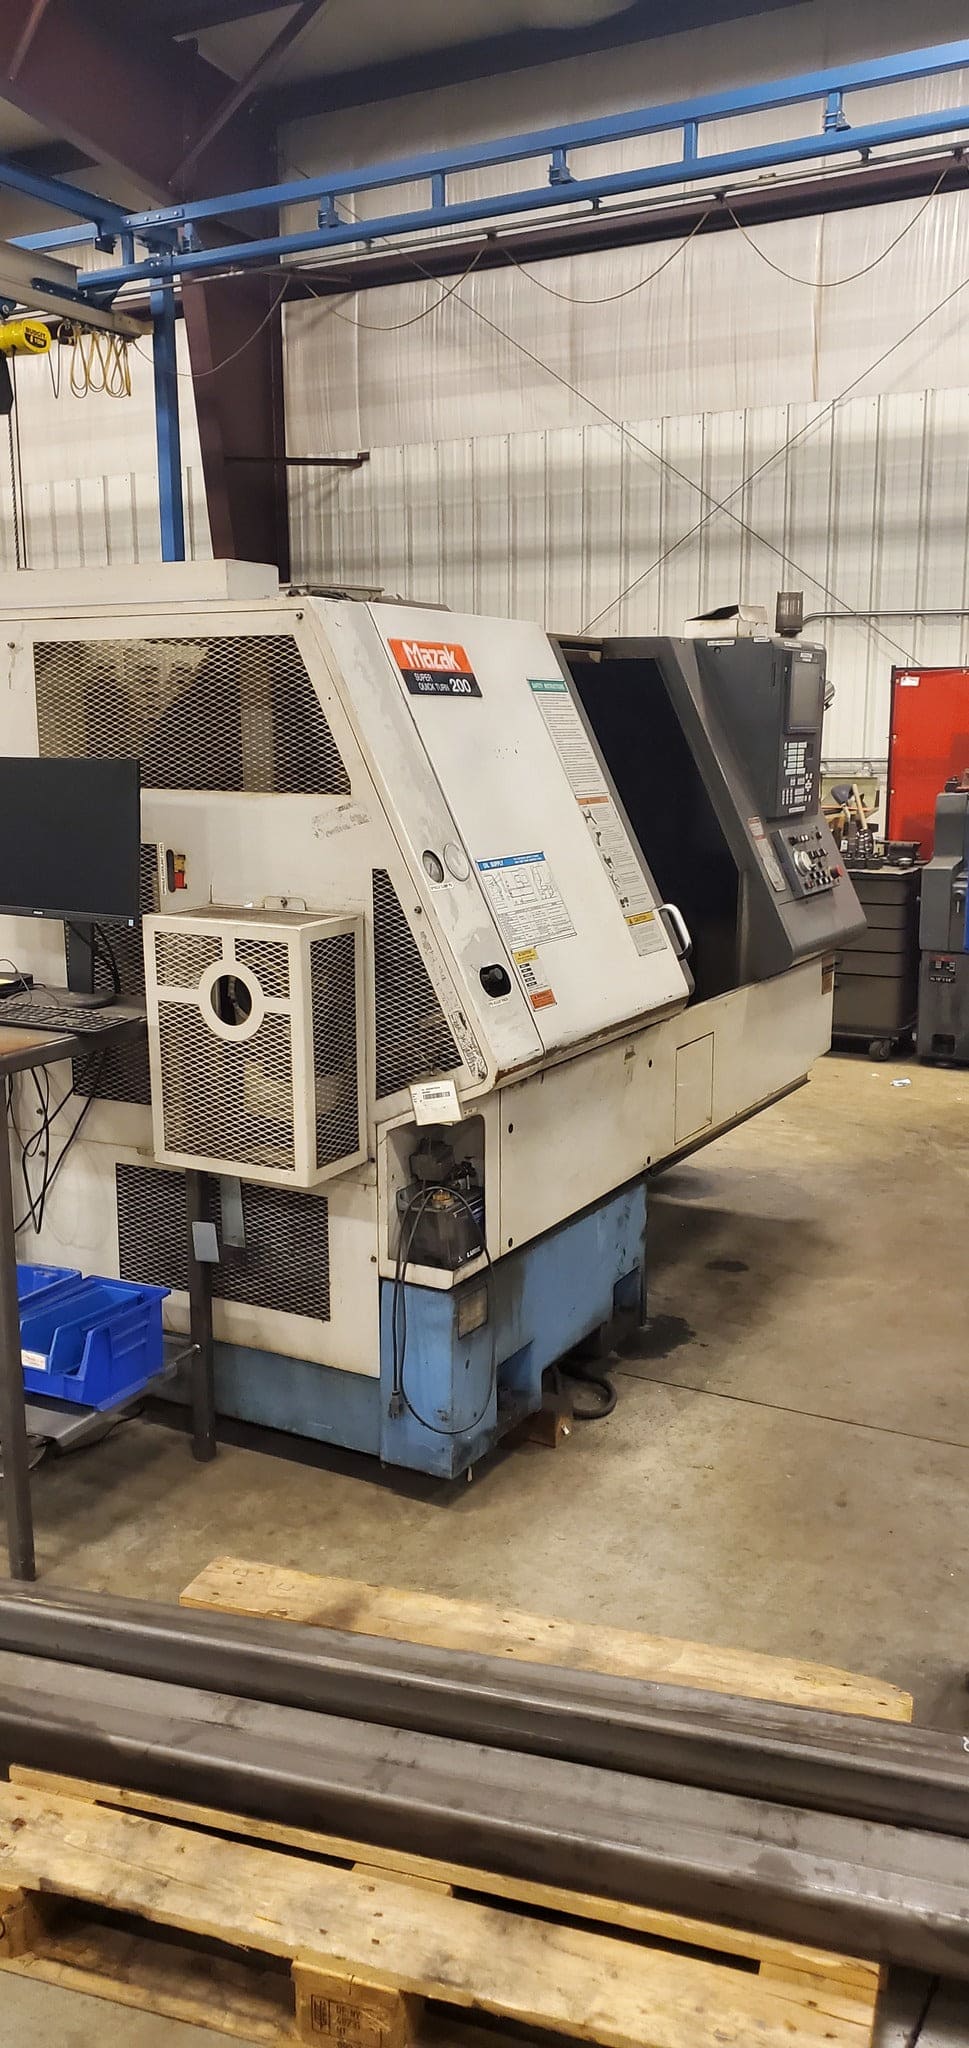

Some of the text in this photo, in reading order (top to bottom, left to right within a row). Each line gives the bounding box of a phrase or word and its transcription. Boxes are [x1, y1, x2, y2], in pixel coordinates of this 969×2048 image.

[401, 641, 462, 671] Mazak
[414, 673, 432, 683] SUPER
[417, 681, 436, 692] QUICK
[450, 678, 472, 694] 200
